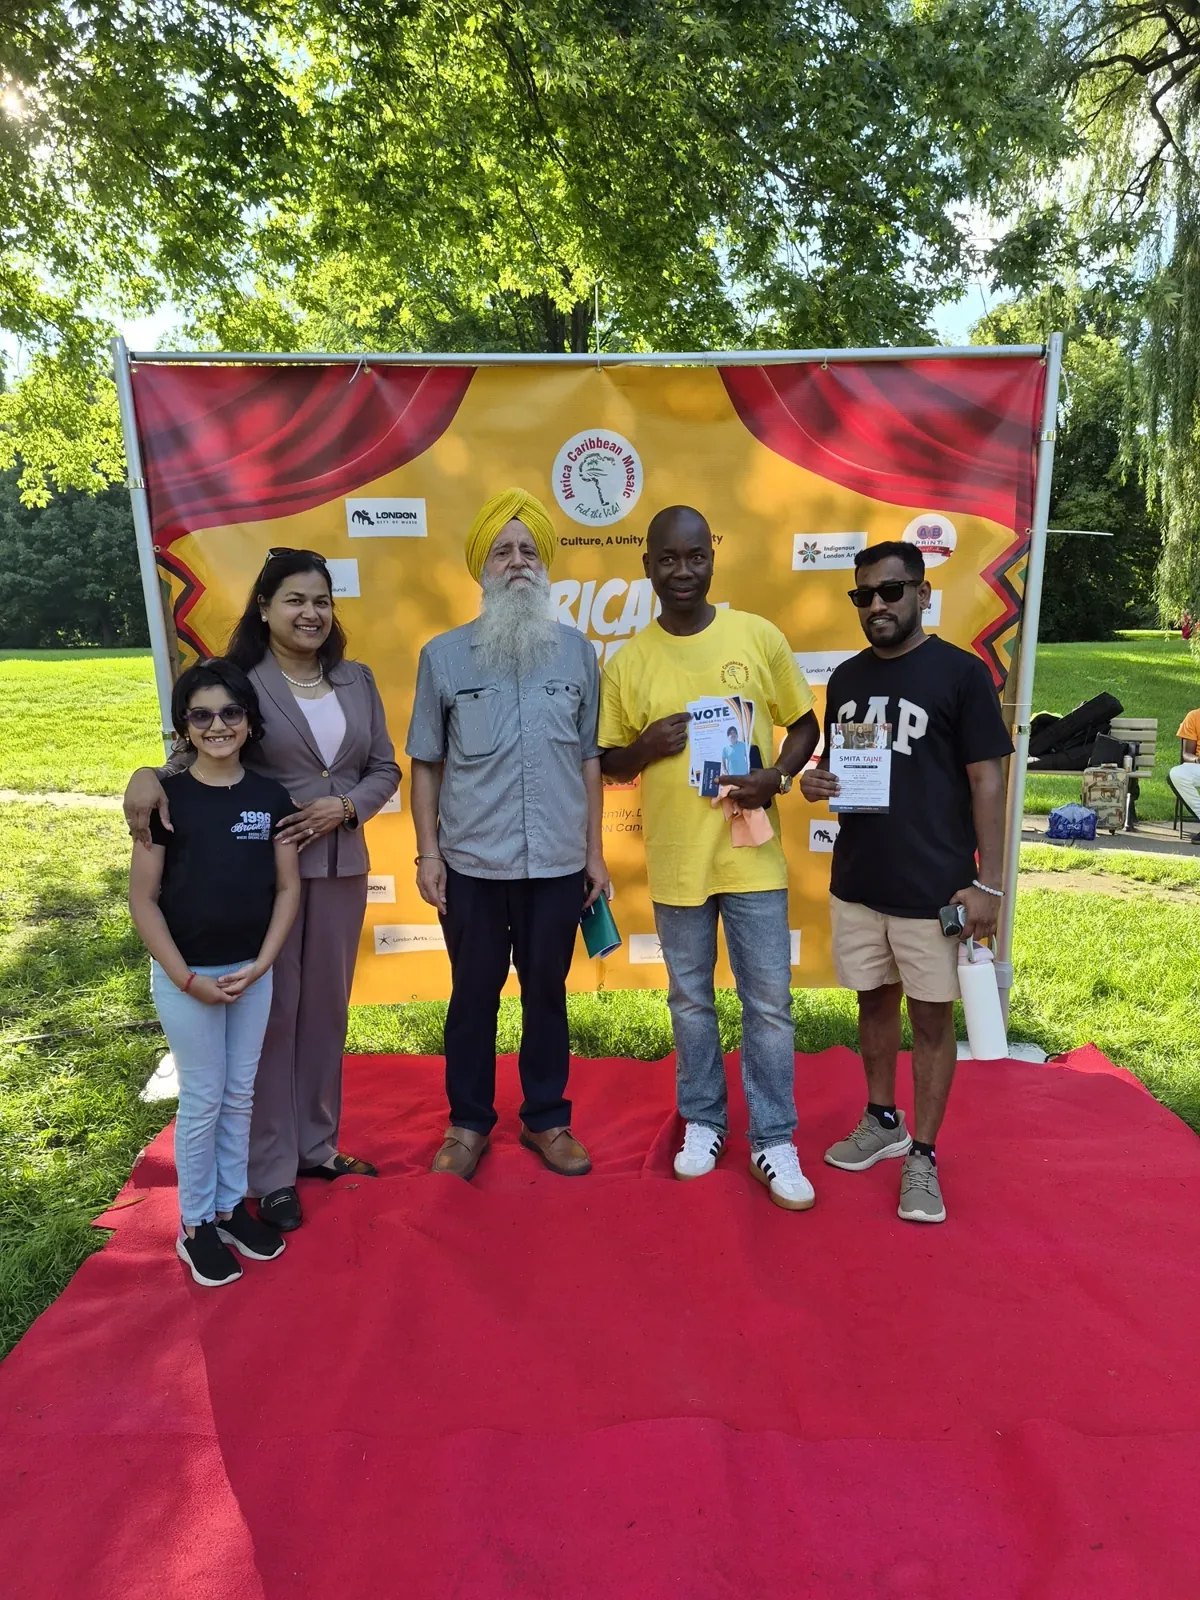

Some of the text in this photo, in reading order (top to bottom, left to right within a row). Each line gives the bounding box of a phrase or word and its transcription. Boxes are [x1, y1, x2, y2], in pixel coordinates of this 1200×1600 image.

[560, 437, 635, 500] Africa Caribbean Mosaic
[376, 511, 417, 519] LONDON
[574, 502, 591, 517] Feel
[590, 508, 602, 519] the
[560, 537, 604, 547] Culture,
[605, 536, 614, 545] A
[615, 534, 644, 547] Unity
[548, 577, 663, 636] RICA
[693, 706, 730, 721] VOTE
[240, 811, 271, 824] 1996
[603, 808, 635, 820] mily.
